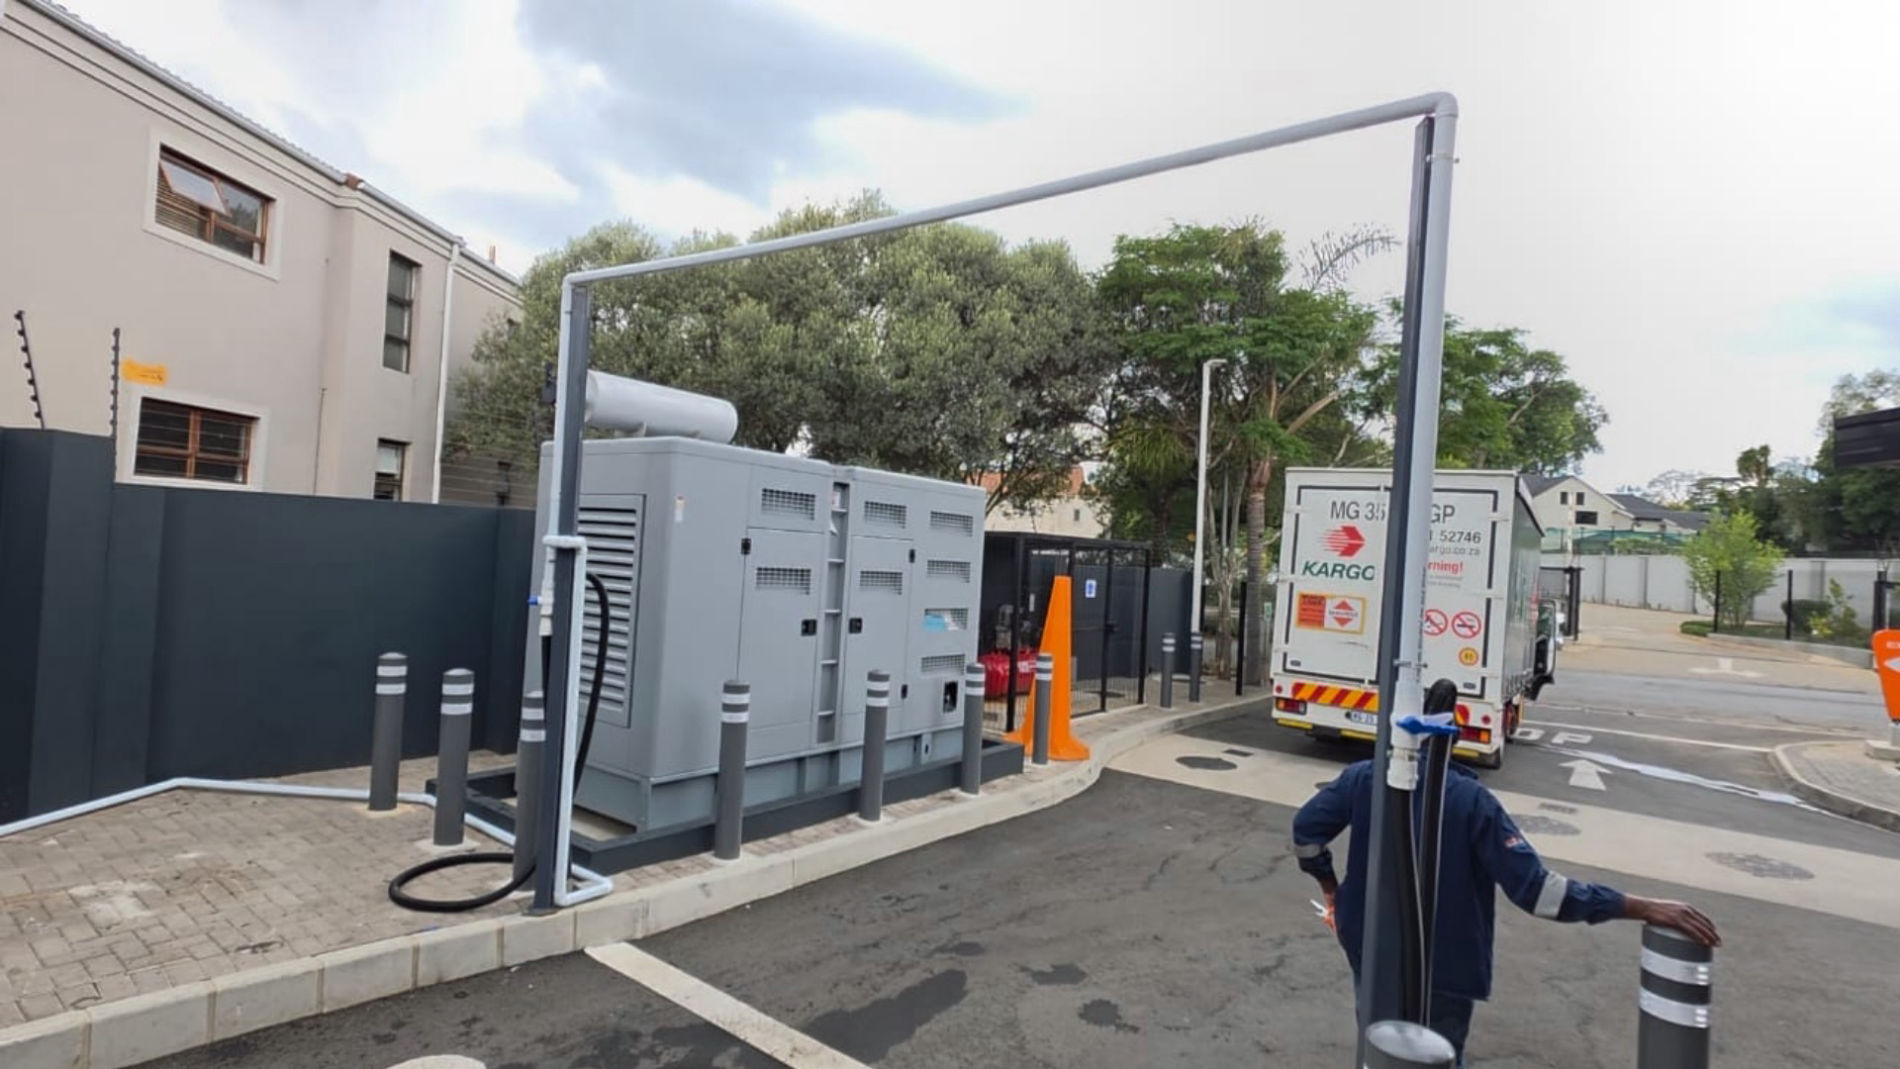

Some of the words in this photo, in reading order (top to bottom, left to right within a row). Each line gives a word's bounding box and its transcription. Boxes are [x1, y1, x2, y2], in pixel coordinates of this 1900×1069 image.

[1330, 500, 1360, 521] MG
[1431, 503, 1456, 524] GP
[1440, 529, 1482, 544] 52746
[1302, 560, 1375, 581] KARGO
[1427, 560, 1464, 575] rning!
[1512, 728, 1592, 744] OP
